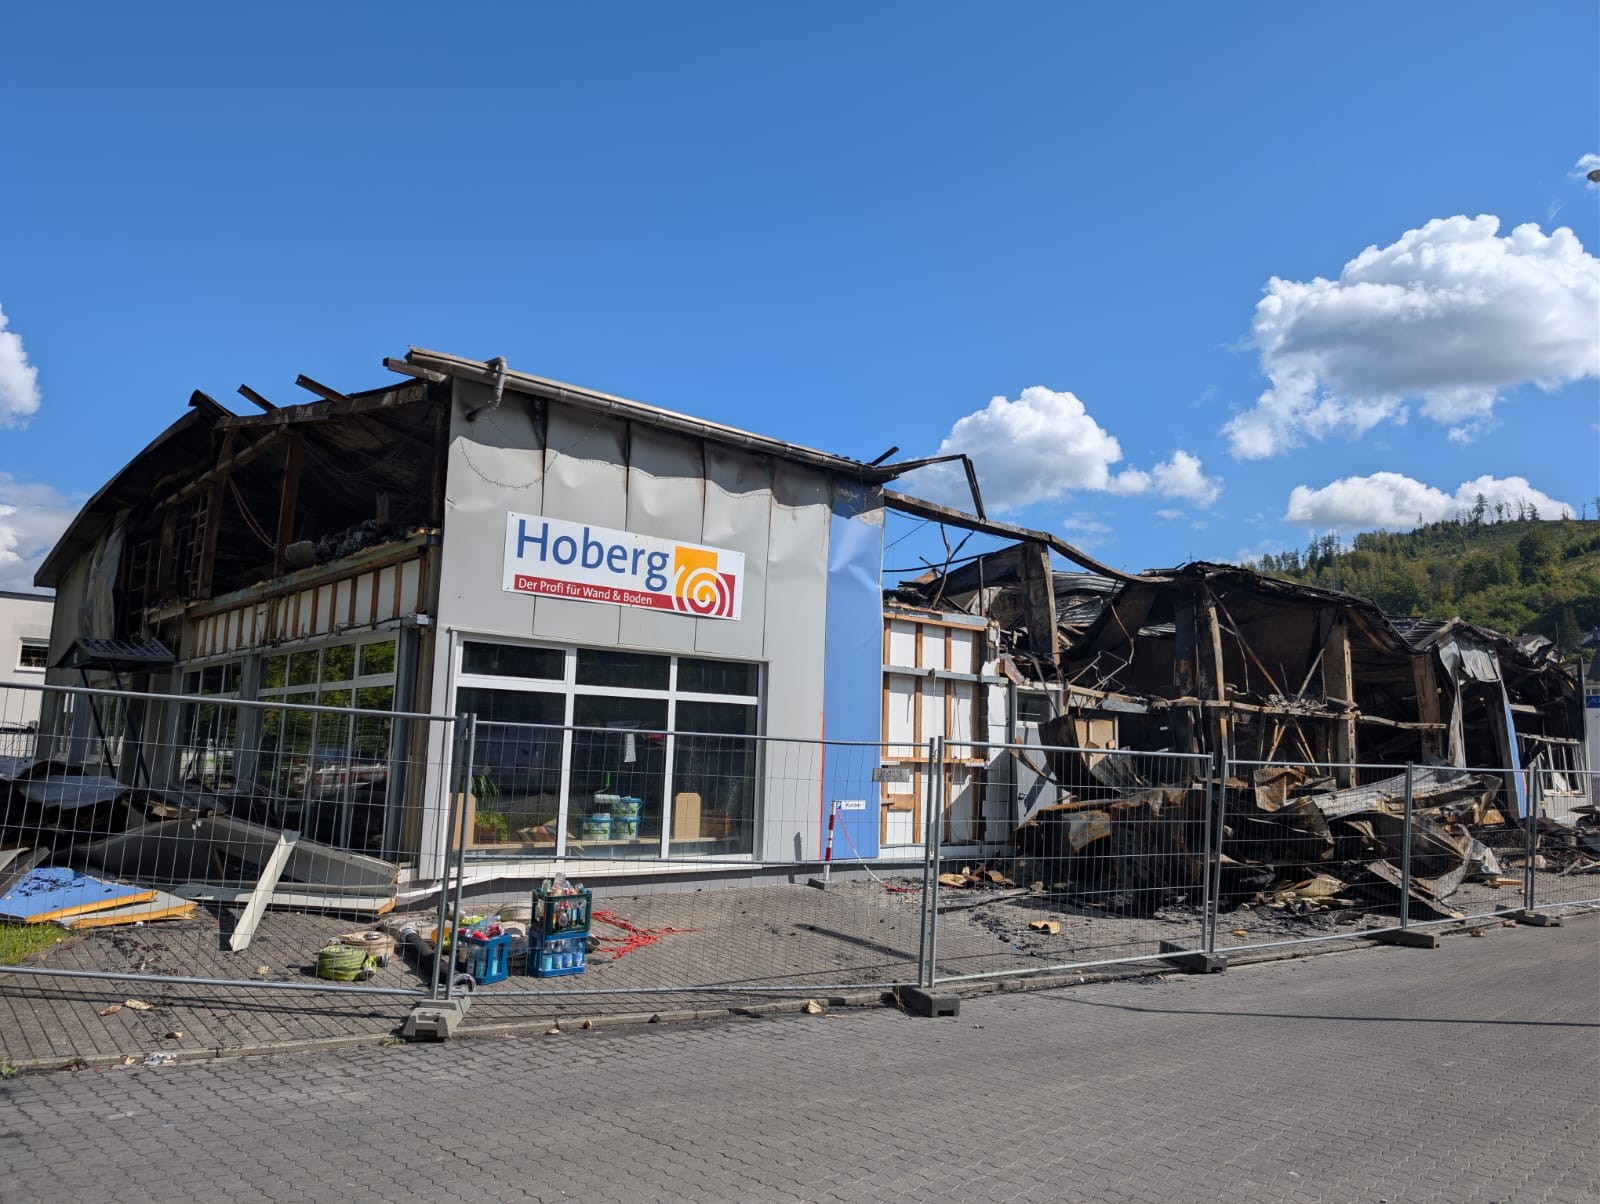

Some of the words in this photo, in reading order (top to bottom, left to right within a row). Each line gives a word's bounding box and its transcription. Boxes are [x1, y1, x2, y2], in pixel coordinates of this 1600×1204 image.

[516, 518, 669, 592] Hoberg
[518, 577, 538, 591] Der
[540, 580, 564, 593] Profi
[566, 583, 581, 596] für
[582, 586, 611, 600] Wand
[612, 590, 621, 601] &
[623, 592, 653, 605] Boden
